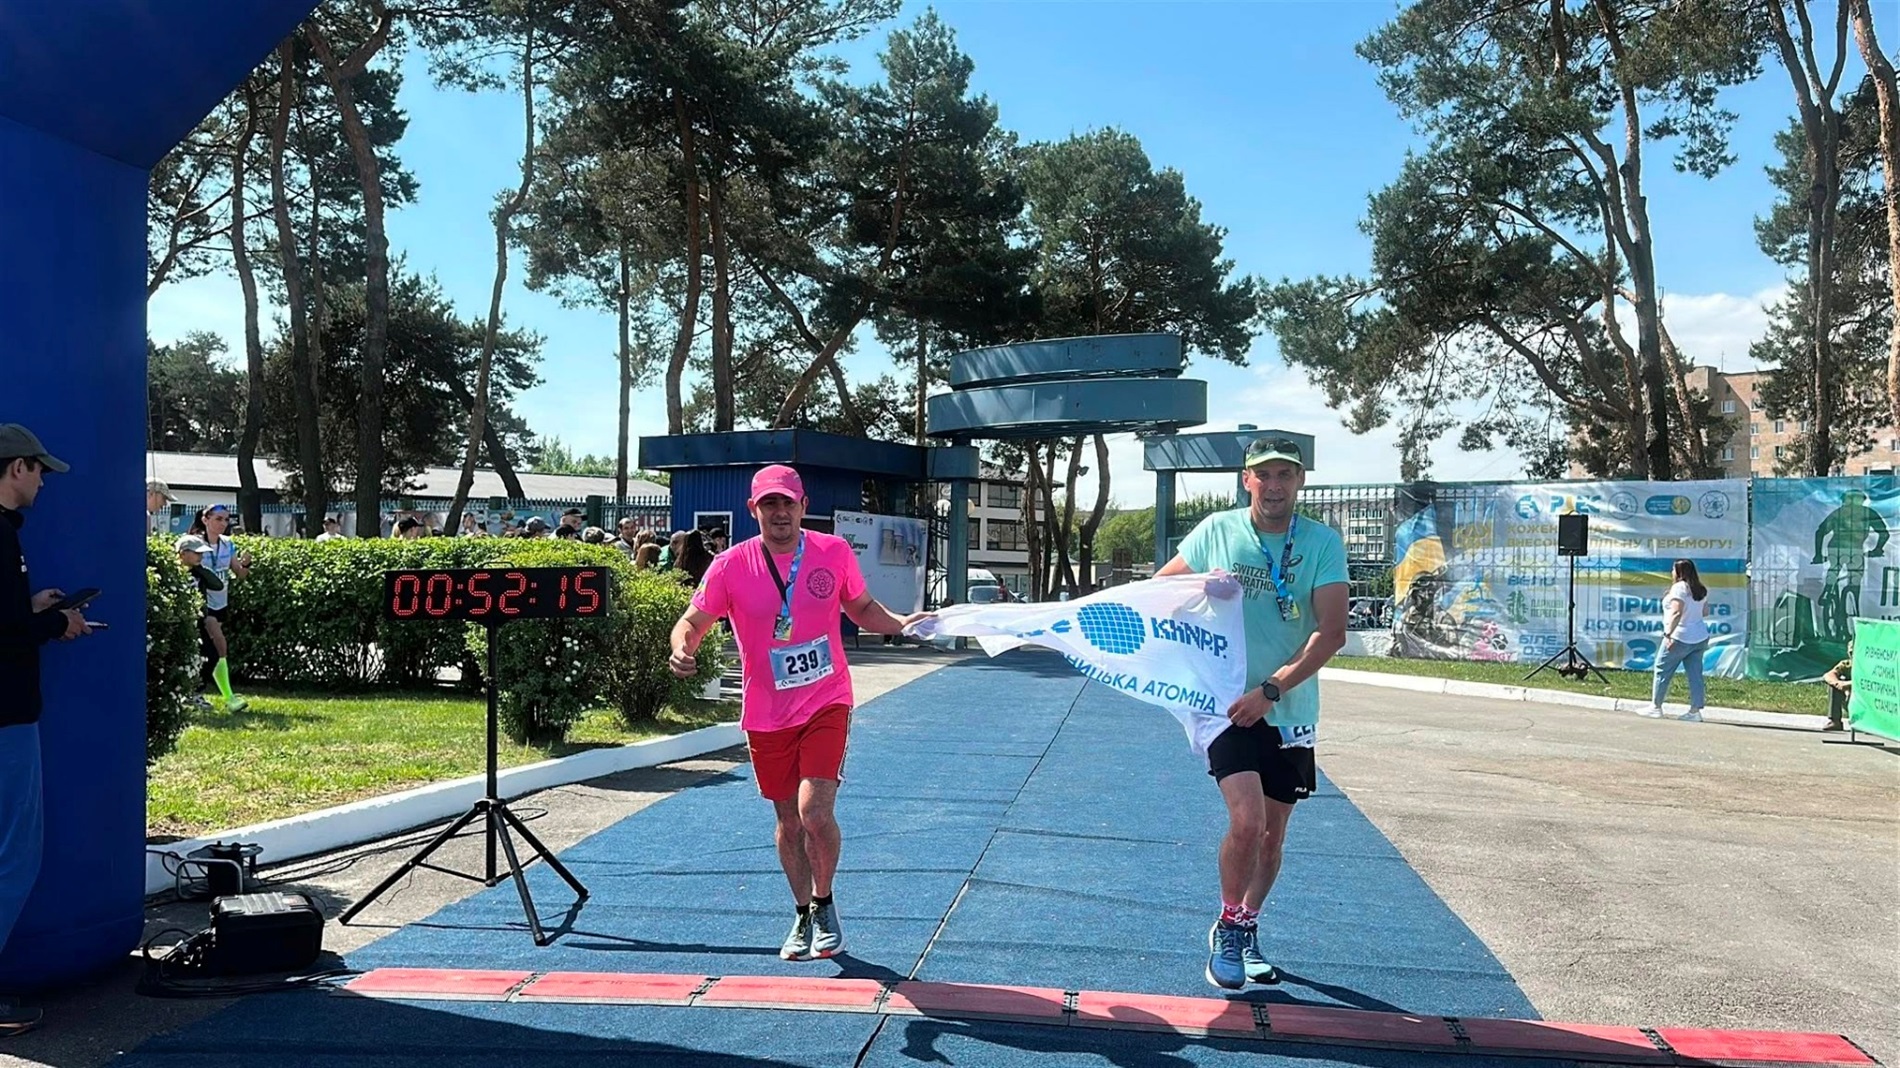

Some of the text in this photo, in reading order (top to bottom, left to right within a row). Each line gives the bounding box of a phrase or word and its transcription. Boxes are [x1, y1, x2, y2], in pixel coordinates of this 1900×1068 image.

[1507, 538, 1558, 548] ВНЕСО
[1647, 538, 1732, 549] ПЕРЕМОГУ!
[392, 571, 599, 616] 00:52:15
[785, 649, 819, 676] 239
[1141, 679, 1217, 714] АТОМНА
